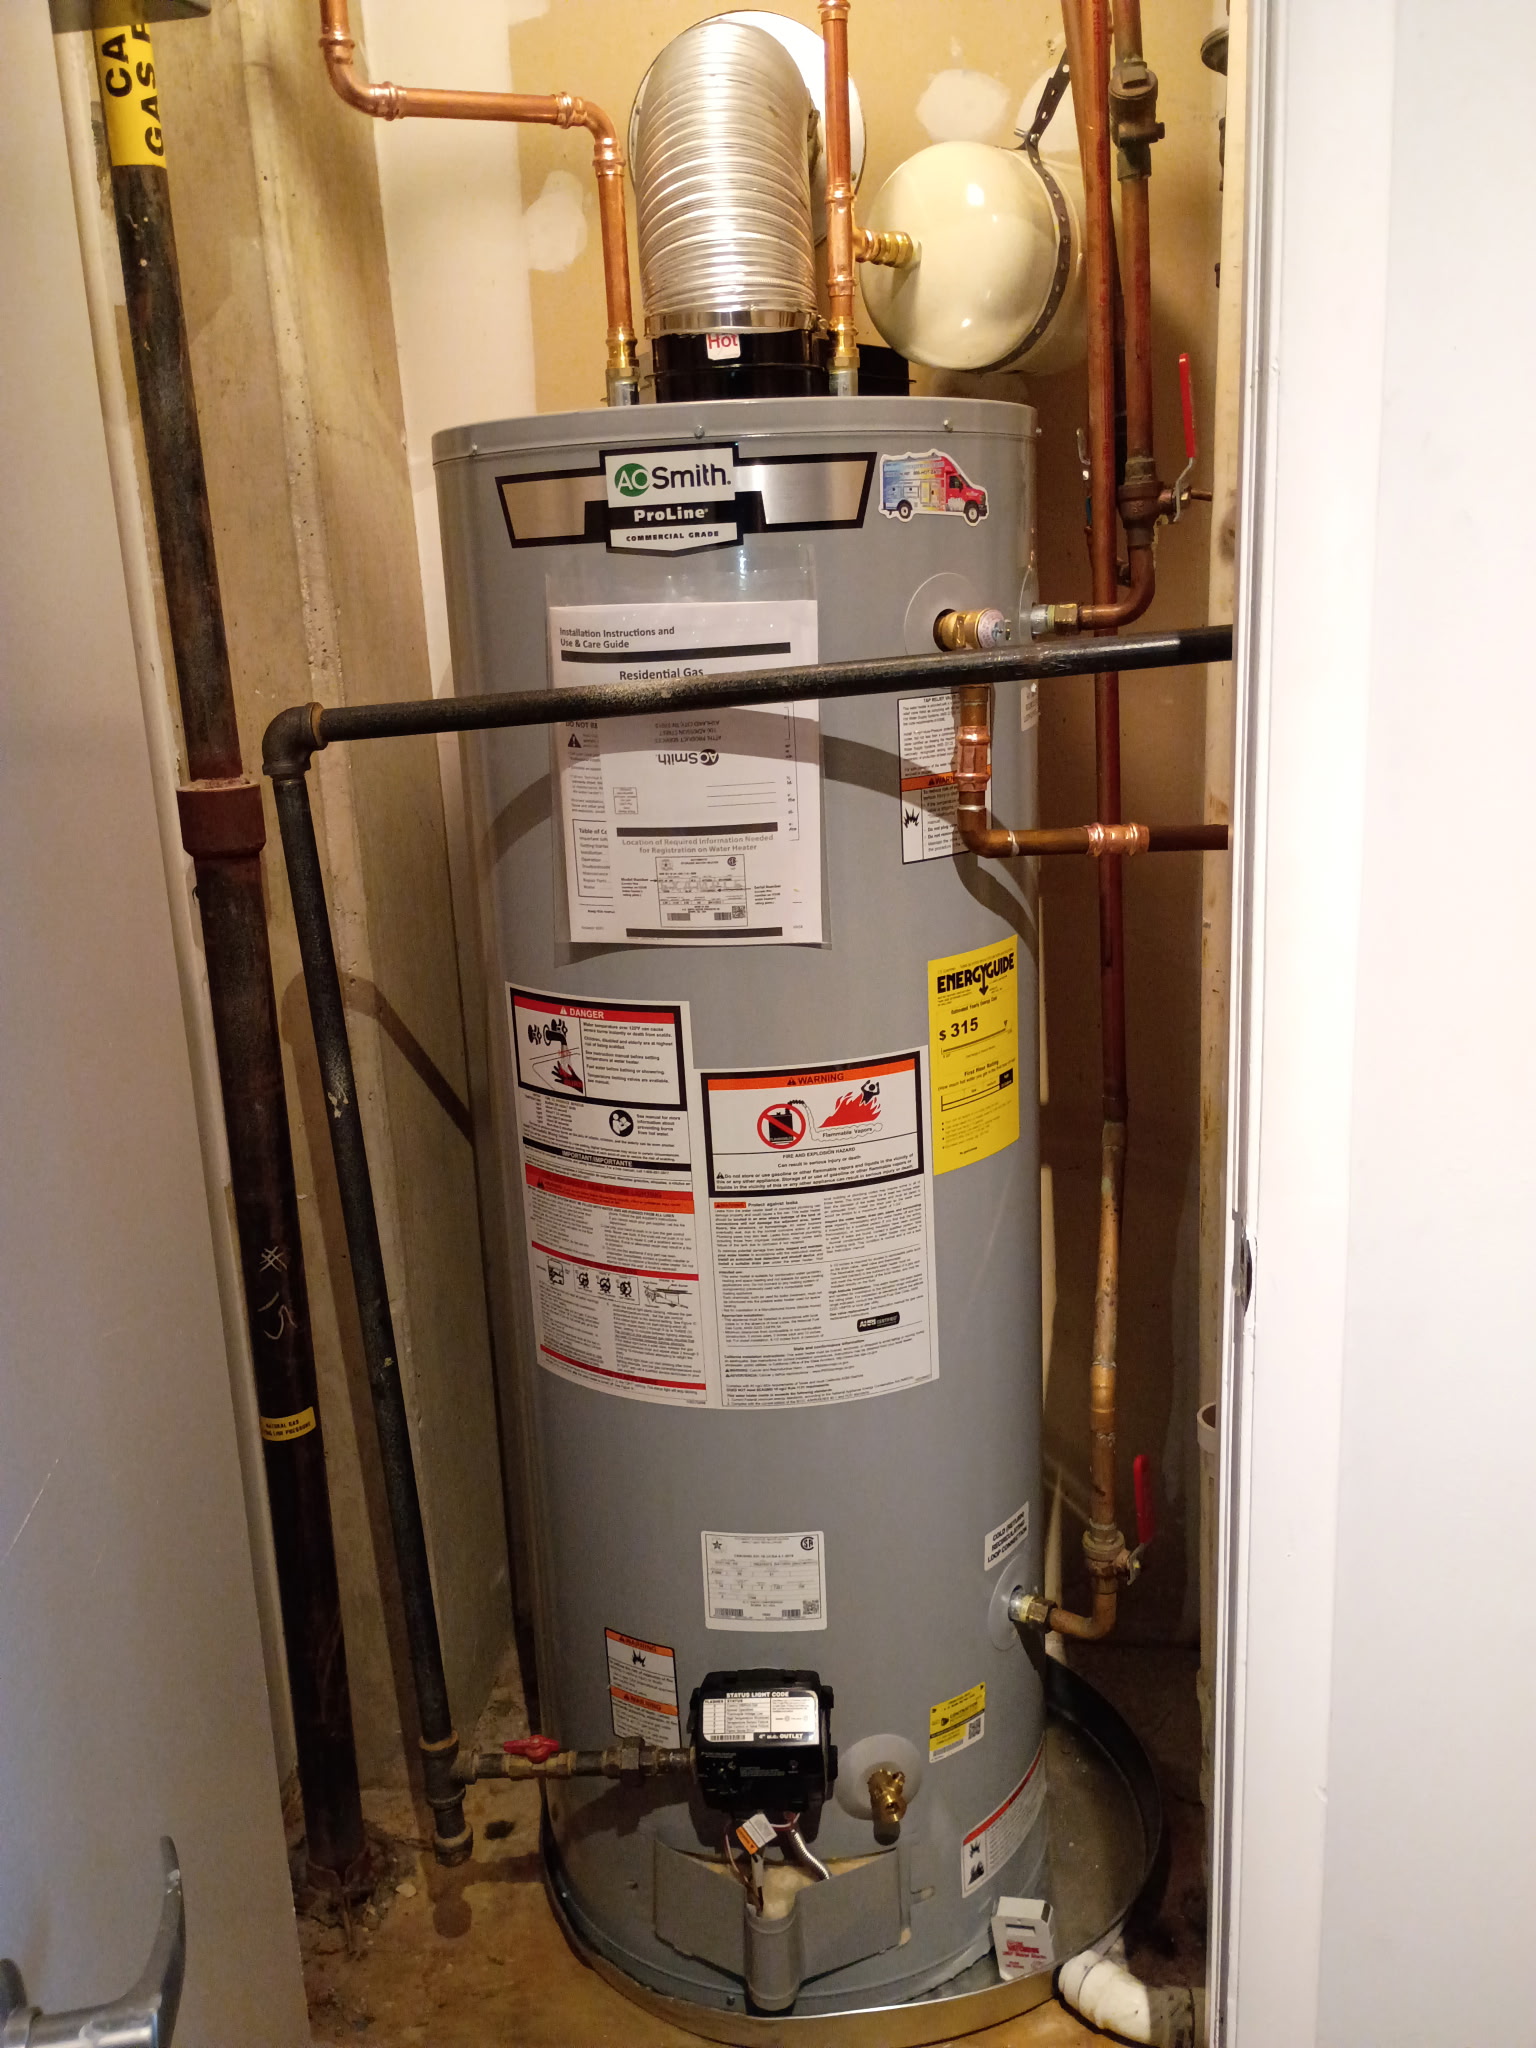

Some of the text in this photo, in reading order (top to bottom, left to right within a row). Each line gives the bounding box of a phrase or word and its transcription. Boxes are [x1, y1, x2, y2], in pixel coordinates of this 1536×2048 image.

[136, 61, 164, 156] GAS
[708, 334, 738, 349] Hot
[626, 530, 719, 542] COMMERCIAL GRADE
[560, 626, 674, 638] Installation Instructions and
[560, 638, 630, 648] Use & Care Guide
[620, 668, 704, 680] Residential Gas
[664, 838, 698, 846] Required
[700, 836, 744, 845] Information
[652, 846, 697, 855] Registration
[937, 952, 1014, 994] ENERGYGUIDE
[570, 1008, 604, 1019] DANGER
[939, 1017, 978, 1041] $ 315
[798, 1073, 844, 1084] WARNING
[807, 1149, 834, 1157] EXPLOSION
